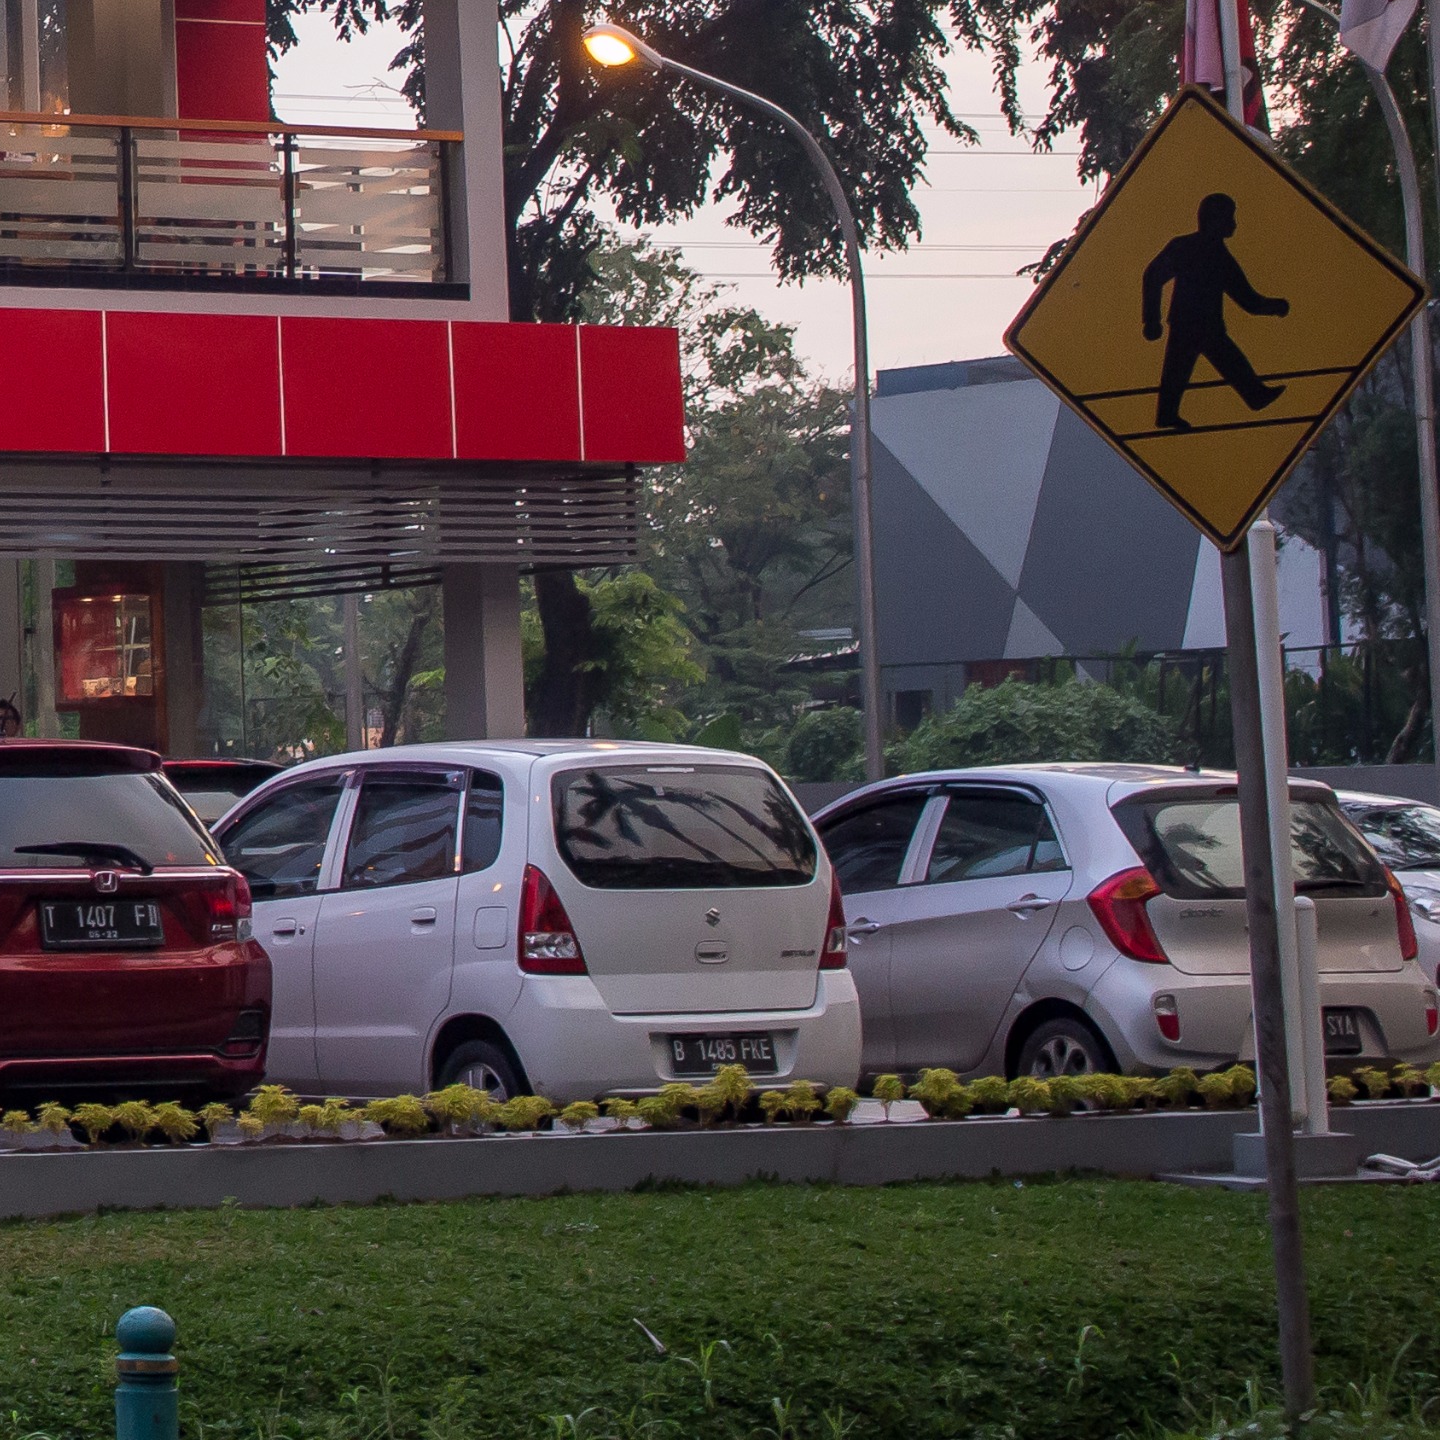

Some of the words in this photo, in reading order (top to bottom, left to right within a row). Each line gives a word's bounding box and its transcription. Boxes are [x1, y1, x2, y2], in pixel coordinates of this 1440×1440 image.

[45, 905, 56, 928] T
[76, 905, 116, 929] 1407
[673, 1039, 686, 1062] B
[740, 1037, 772, 1061] FKE
